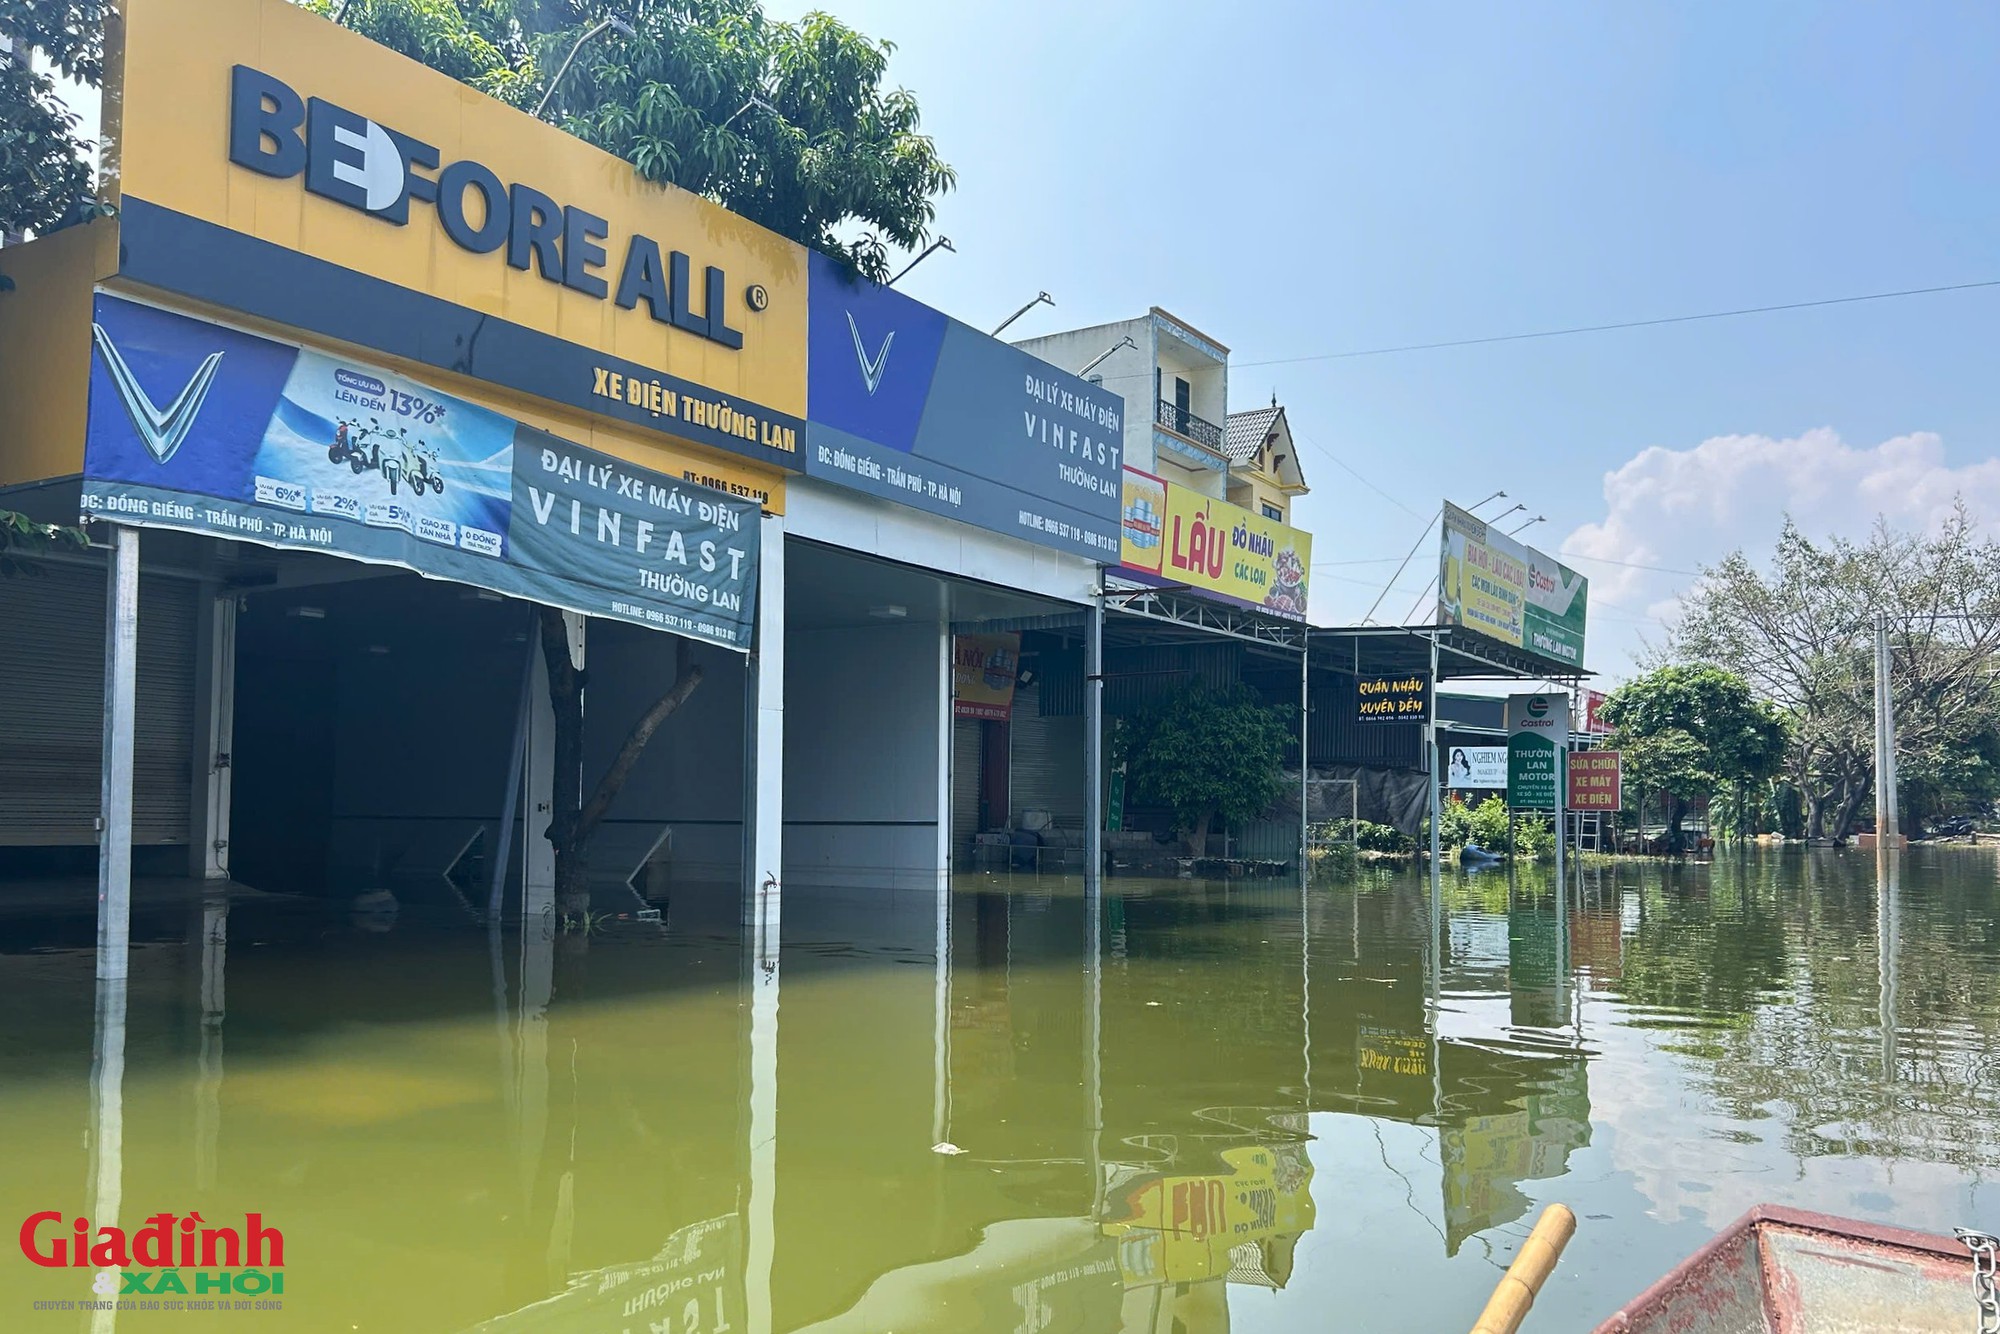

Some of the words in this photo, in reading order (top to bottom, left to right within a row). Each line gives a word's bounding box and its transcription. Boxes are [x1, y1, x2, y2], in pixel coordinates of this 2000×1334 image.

[335, 390, 358, 404] LÊN
[360, 397, 386, 412] ĐẾN
[593, 367, 623, 400] XE
[627, 380, 677, 417] ĐIỆN
[682, 395, 756, 441] THƯỜNG
[761, 421, 795, 453] LAN
[1025, 374, 1044, 403] ĐẠI
[1047, 382, 1058, 405] LÝ
[1061, 390, 1073, 413] XE
[1075, 396, 1096, 422] MÁY
[1098, 406, 1119, 434] ĐIỆN
[1024, 411, 1119, 470] VINFAST
[541, 448, 582, 484] ĐẠI
[588, 464, 613, 490] LÝ
[617, 474, 644, 501] XE
[649, 485, 692, 516] MÁY
[698, 501, 739, 533] ĐIỆN
[818, 445, 832, 465] ĐC:
[857, 456, 880, 480] GIẾNG
[907, 474, 922, 493] PHÚ
[928, 481, 937, 498] TP.
[938, 483, 948, 501] HÀ
[949, 486, 961, 508] NỘI
[1059, 463, 1097, 491] THƯỜNG
[1100, 479, 1116, 499] LAN
[152, 500, 194, 520] GIẾNG
[205, 509, 236, 528] TRẦN
[240, 517, 262, 532] PHÚ
[273, 522, 286, 537] TP.
[289, 525, 306, 540] HÀ
[310, 527, 332, 544] NỘI
[421, 518, 439, 529] GIAO
[440, 523, 450, 531] XE
[528, 486, 745, 580] VINFAST
[1019, 510, 1044, 530] HOTLINE:
[1045, 518, 1058, 535] 0966
[1059, 523, 1070, 538] 537
[1070, 526, 1081, 541] 119
[1232, 516, 1246, 549] ĐỒ
[1248, 531, 1274, 561] NHẬU
[1234, 559, 1249, 581] CÁC
[1250, 567, 1266, 589] LOẠI
[639, 568, 709, 602] THƯỜNG
[713, 589, 740, 612] LAN
[612, 601, 645, 619] HOTLINE:
[646, 609, 664, 623] 0966
[665, 615, 678, 626] 537
[680, 618, 692, 630] 119
[1359, 678, 1390, 696] QUÁN
[1392, 676, 1424, 696] NHẬU
[1359, 698, 1396, 715] XUYÊN
[1398, 697, 1423, 713] ĐÊM
[1520, 719, 1554, 728] Castrol
[1515, 748, 1555, 758] THƯỜN
[1526, 761, 1547, 770] LAN
[1570, 756, 1589, 770] SỬA
[1591, 757, 1617, 770] CHỮA
[1519, 773, 1555, 781] MOTOR
[1576, 776, 1589, 787] XE
[1590, 774, 1612, 787] MÁY
[1575, 794, 1588, 805] XE
[1589, 791, 1612, 807] ĐIỆN
